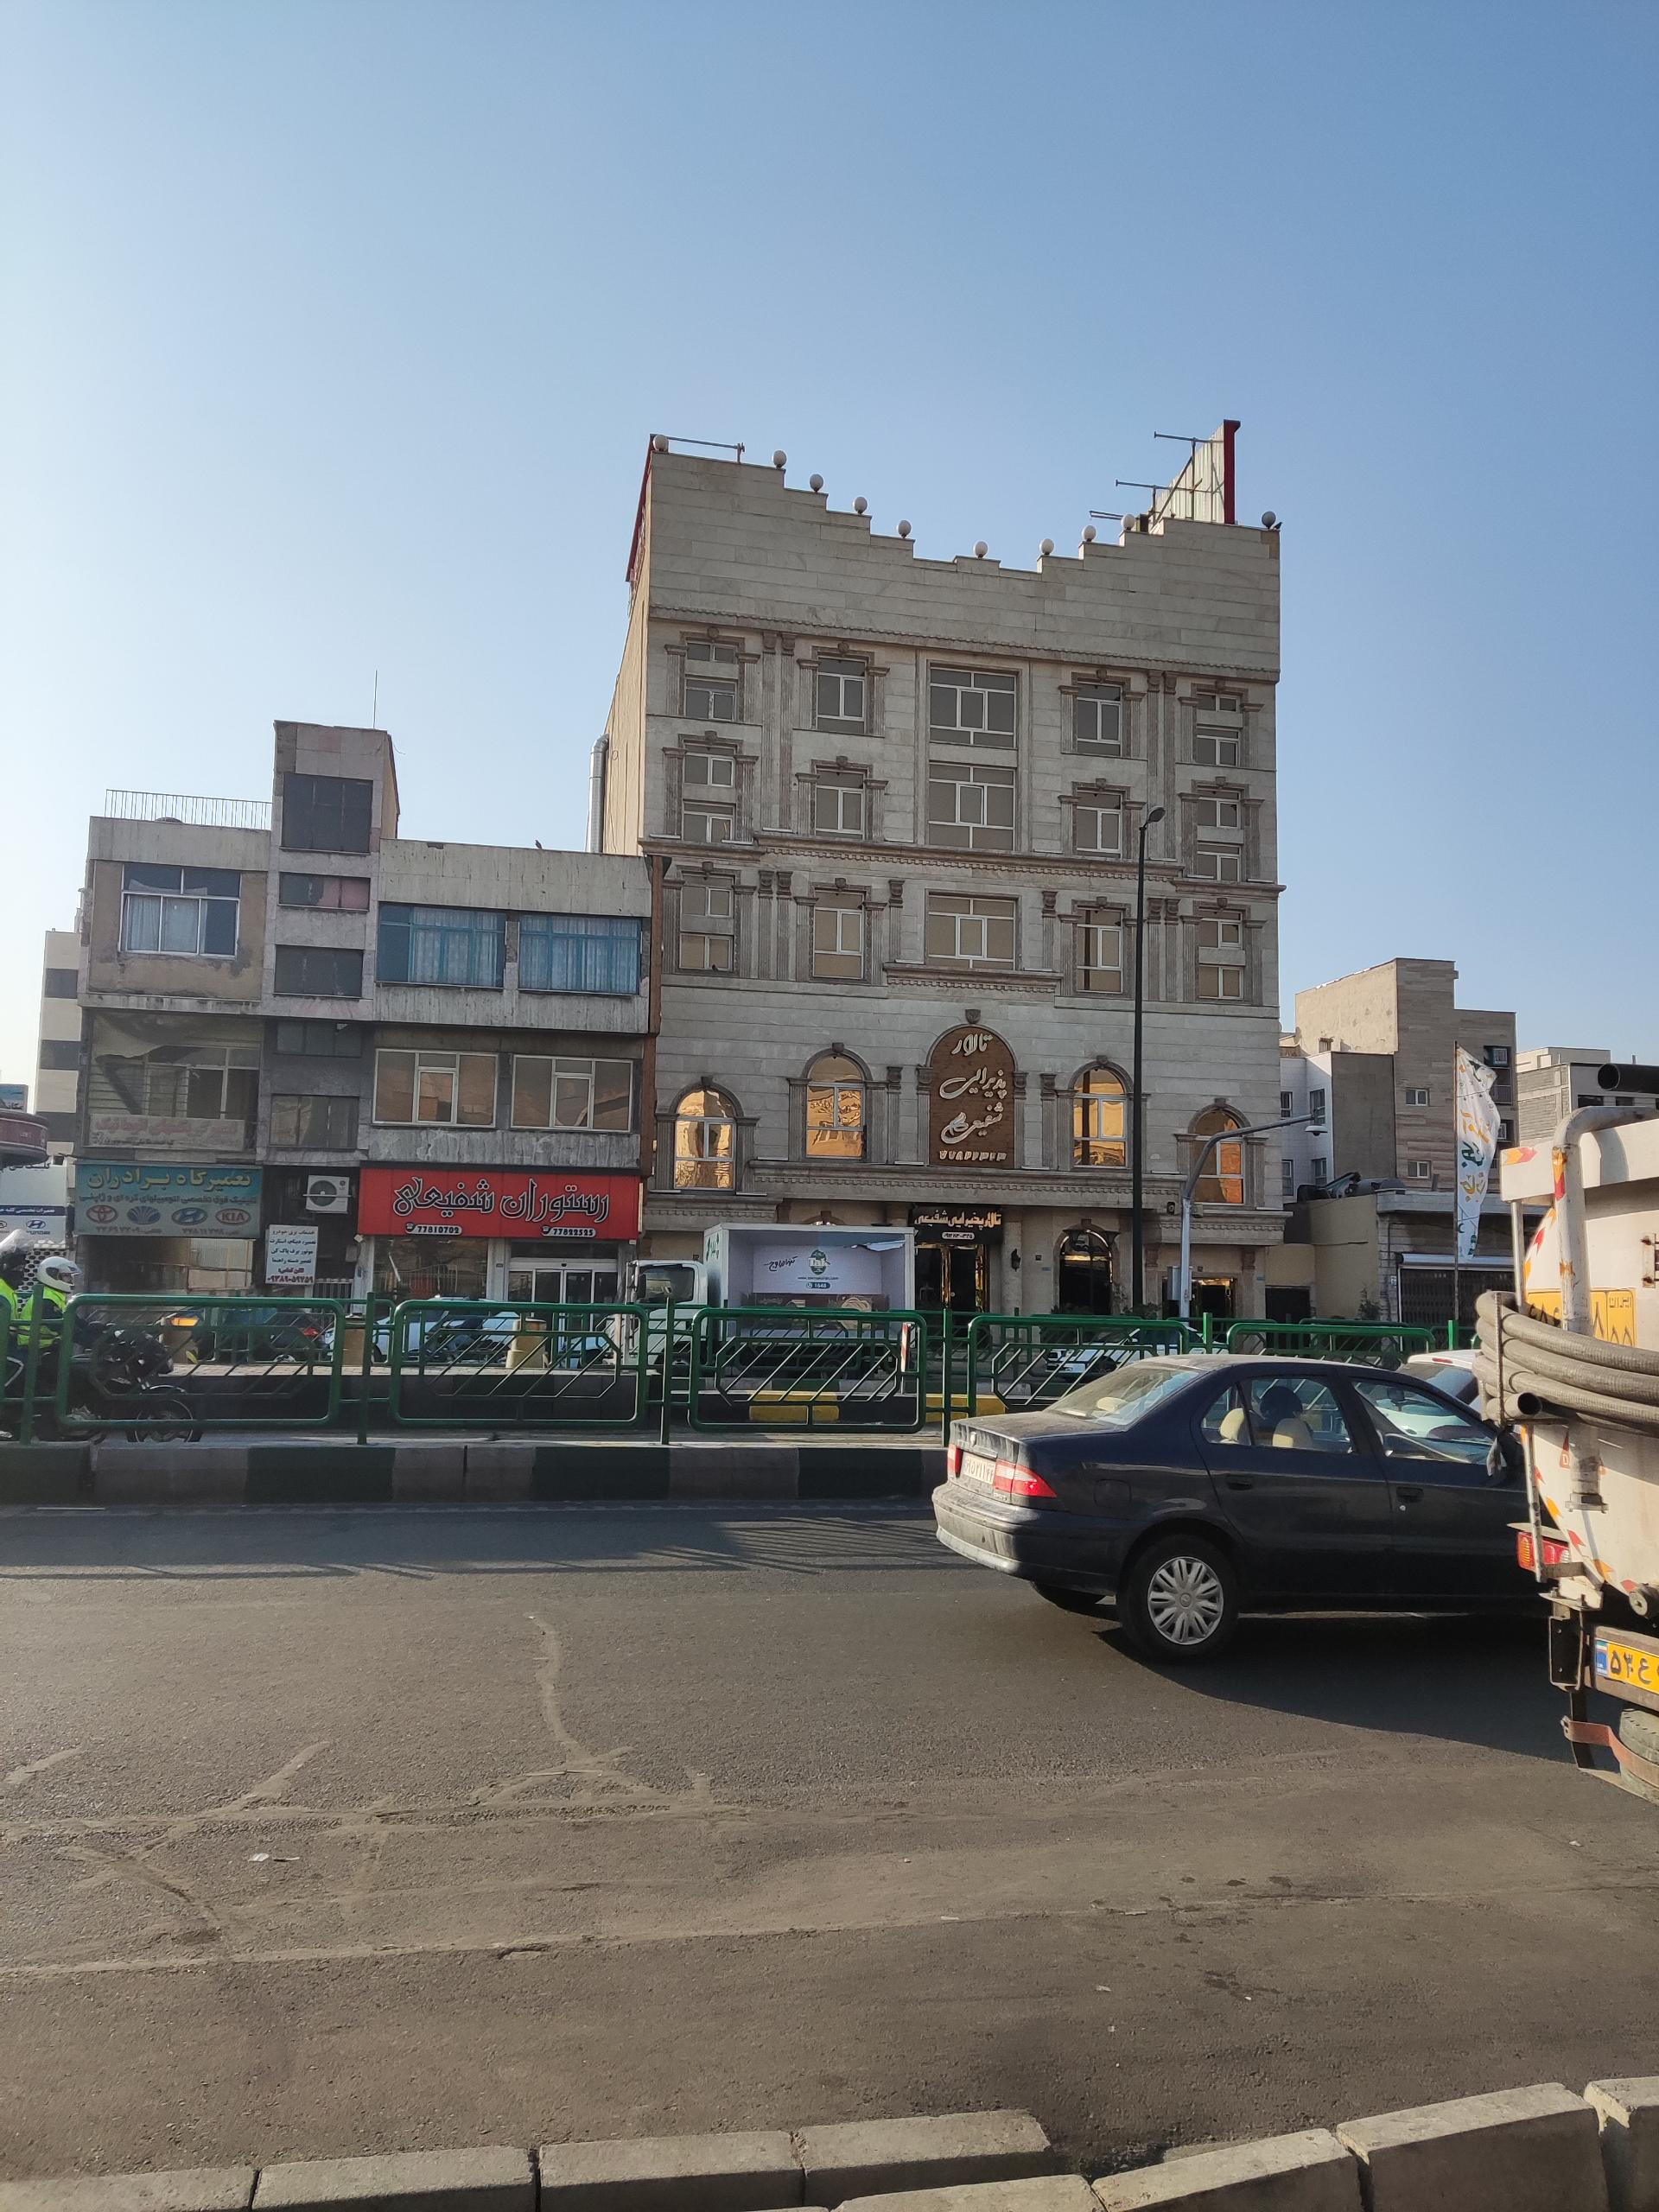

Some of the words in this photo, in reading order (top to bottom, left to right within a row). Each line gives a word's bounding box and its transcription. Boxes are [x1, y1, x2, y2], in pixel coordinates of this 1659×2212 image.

[951, 1033, 994, 1056] تالار
[939, 1066, 1007, 1100] پذیرایی
[88, 1167, 170, 1191] برادران
[393, 1176, 495, 1217] شفیعی
[500, 1178, 609, 1223] رستوران
[221, 1213, 245, 1222] KIA
[552, 1228, 594, 1236] 77822525
